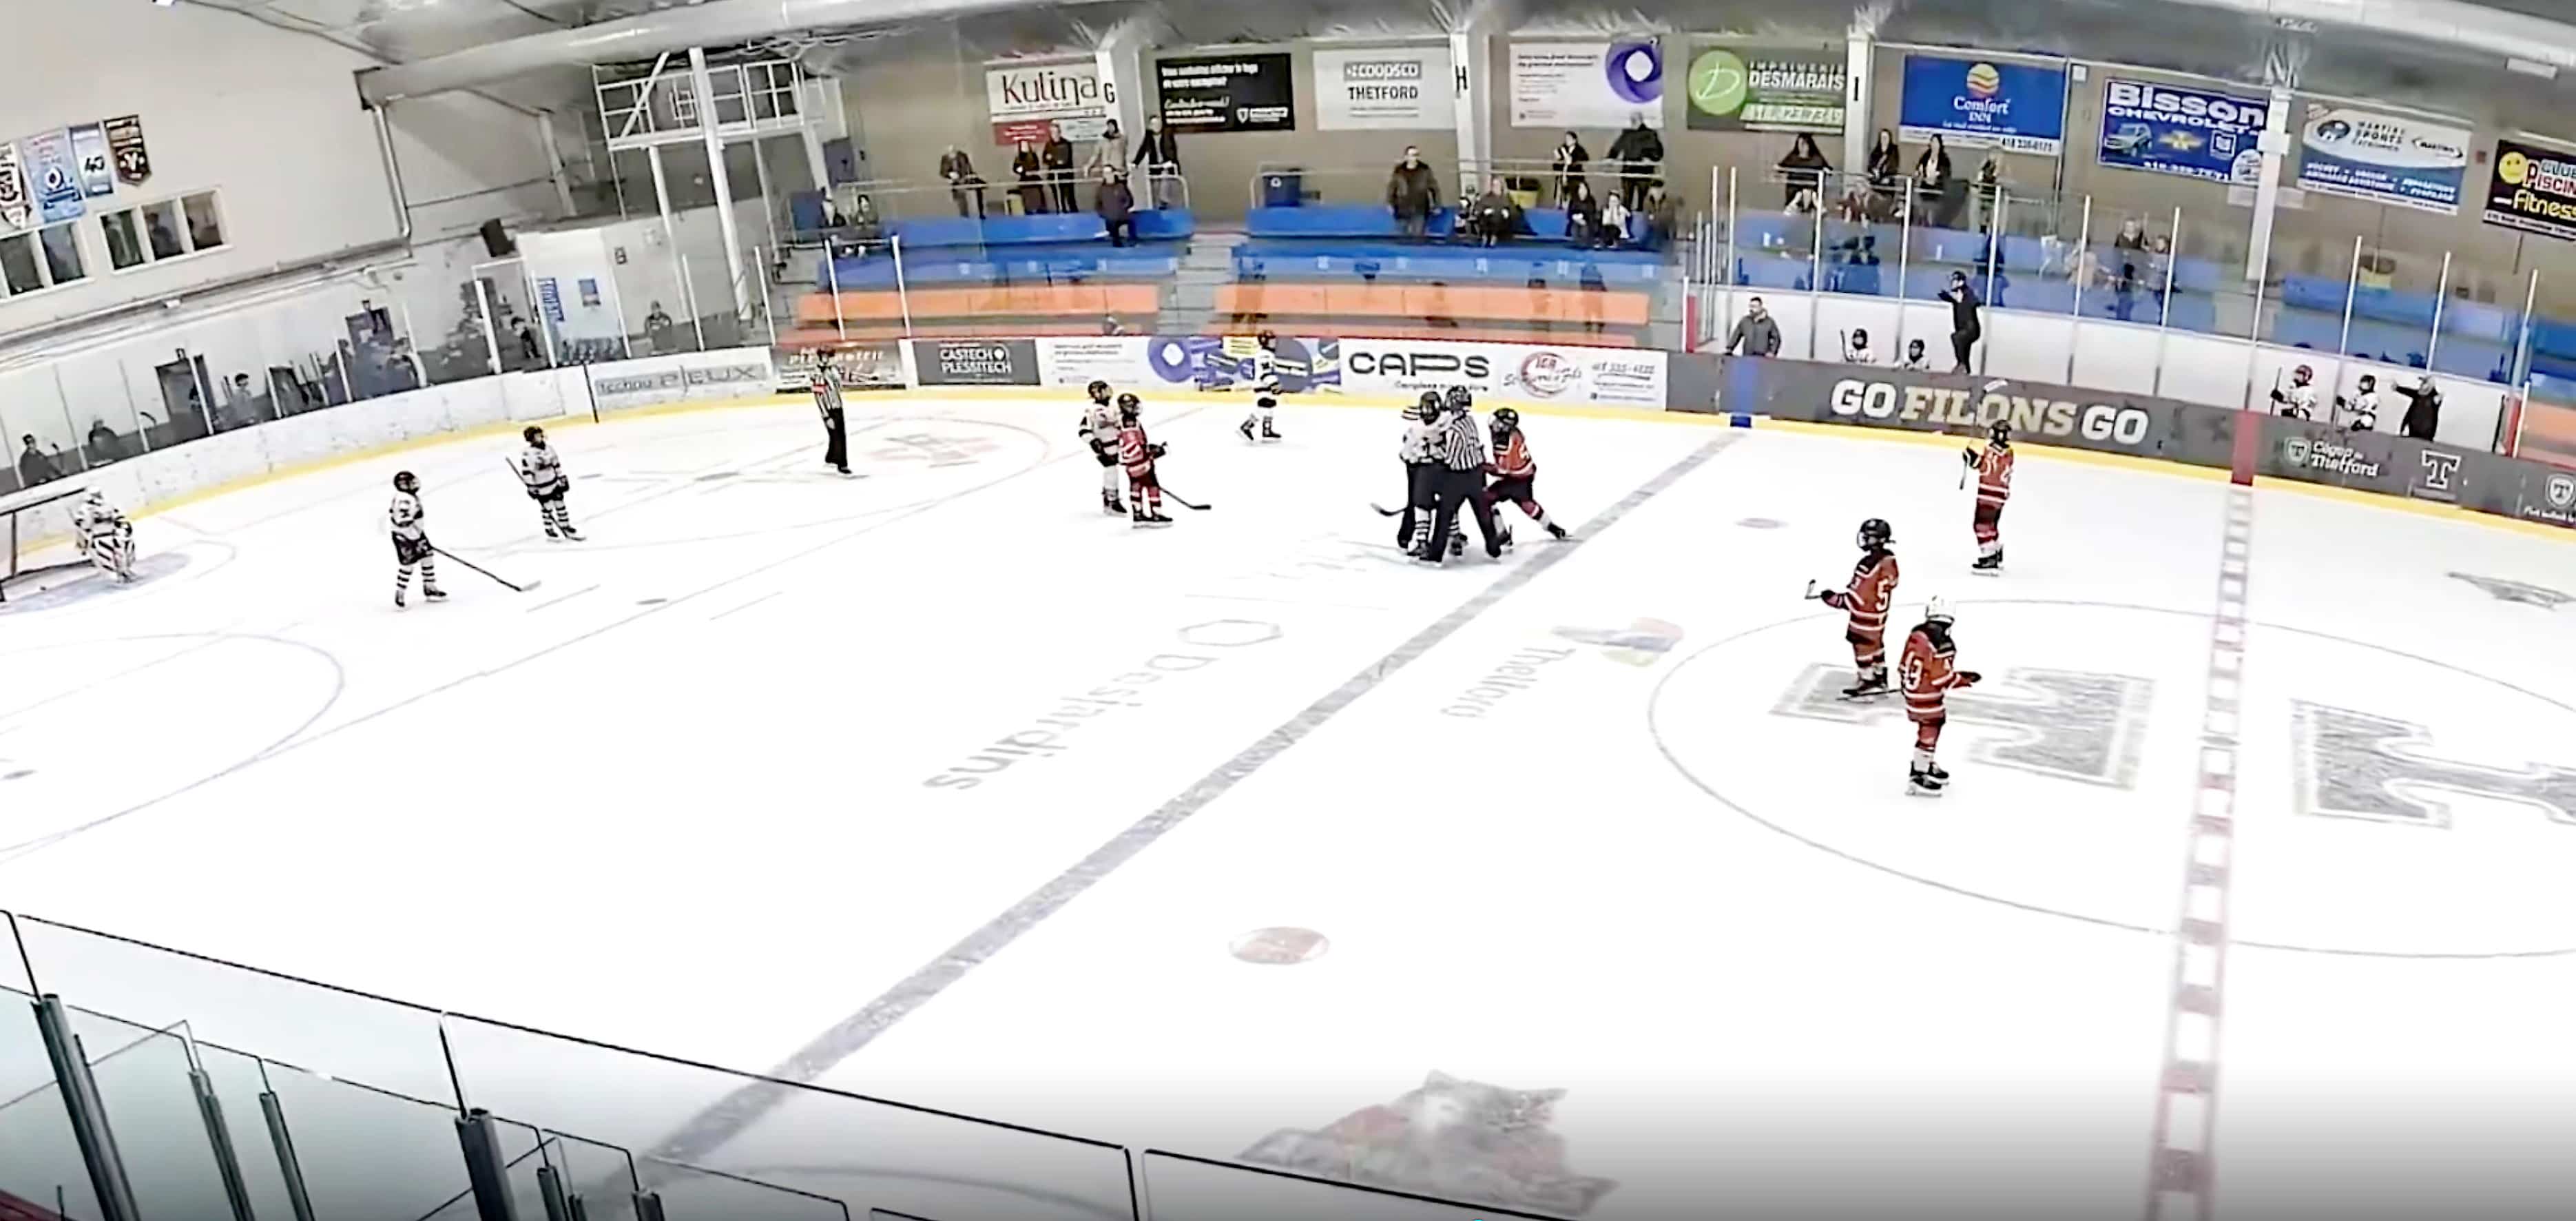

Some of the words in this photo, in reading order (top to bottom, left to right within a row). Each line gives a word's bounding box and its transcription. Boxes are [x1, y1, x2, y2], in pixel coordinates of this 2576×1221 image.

[1003, 71, 1098, 105] Kulina
[1455, 65, 1468, 94] H
[1748, 71, 1846, 91] DESMARAIS
[1103, 82, 1116, 104] G
[1347, 85, 1419, 101] THETFORD
[1953, 96, 2012, 116] Comfort
[2108, 83, 2265, 127] Bisson
[2108, 106, 2251, 134] CHEVROLET
[2355, 130, 2404, 145] SPORTS
[939, 347, 993, 360] CASTECH
[1349, 352, 1490, 378] CAPS
[941, 360, 1012, 374] PLESSITECH
[1831, 379, 1898, 418] GO
[1900, 385, 2079, 436] FILONS
[2081, 404, 2149, 445] GO
[2422, 449, 2462, 489] T
[921, 653, 1221, 791] Desjardins
